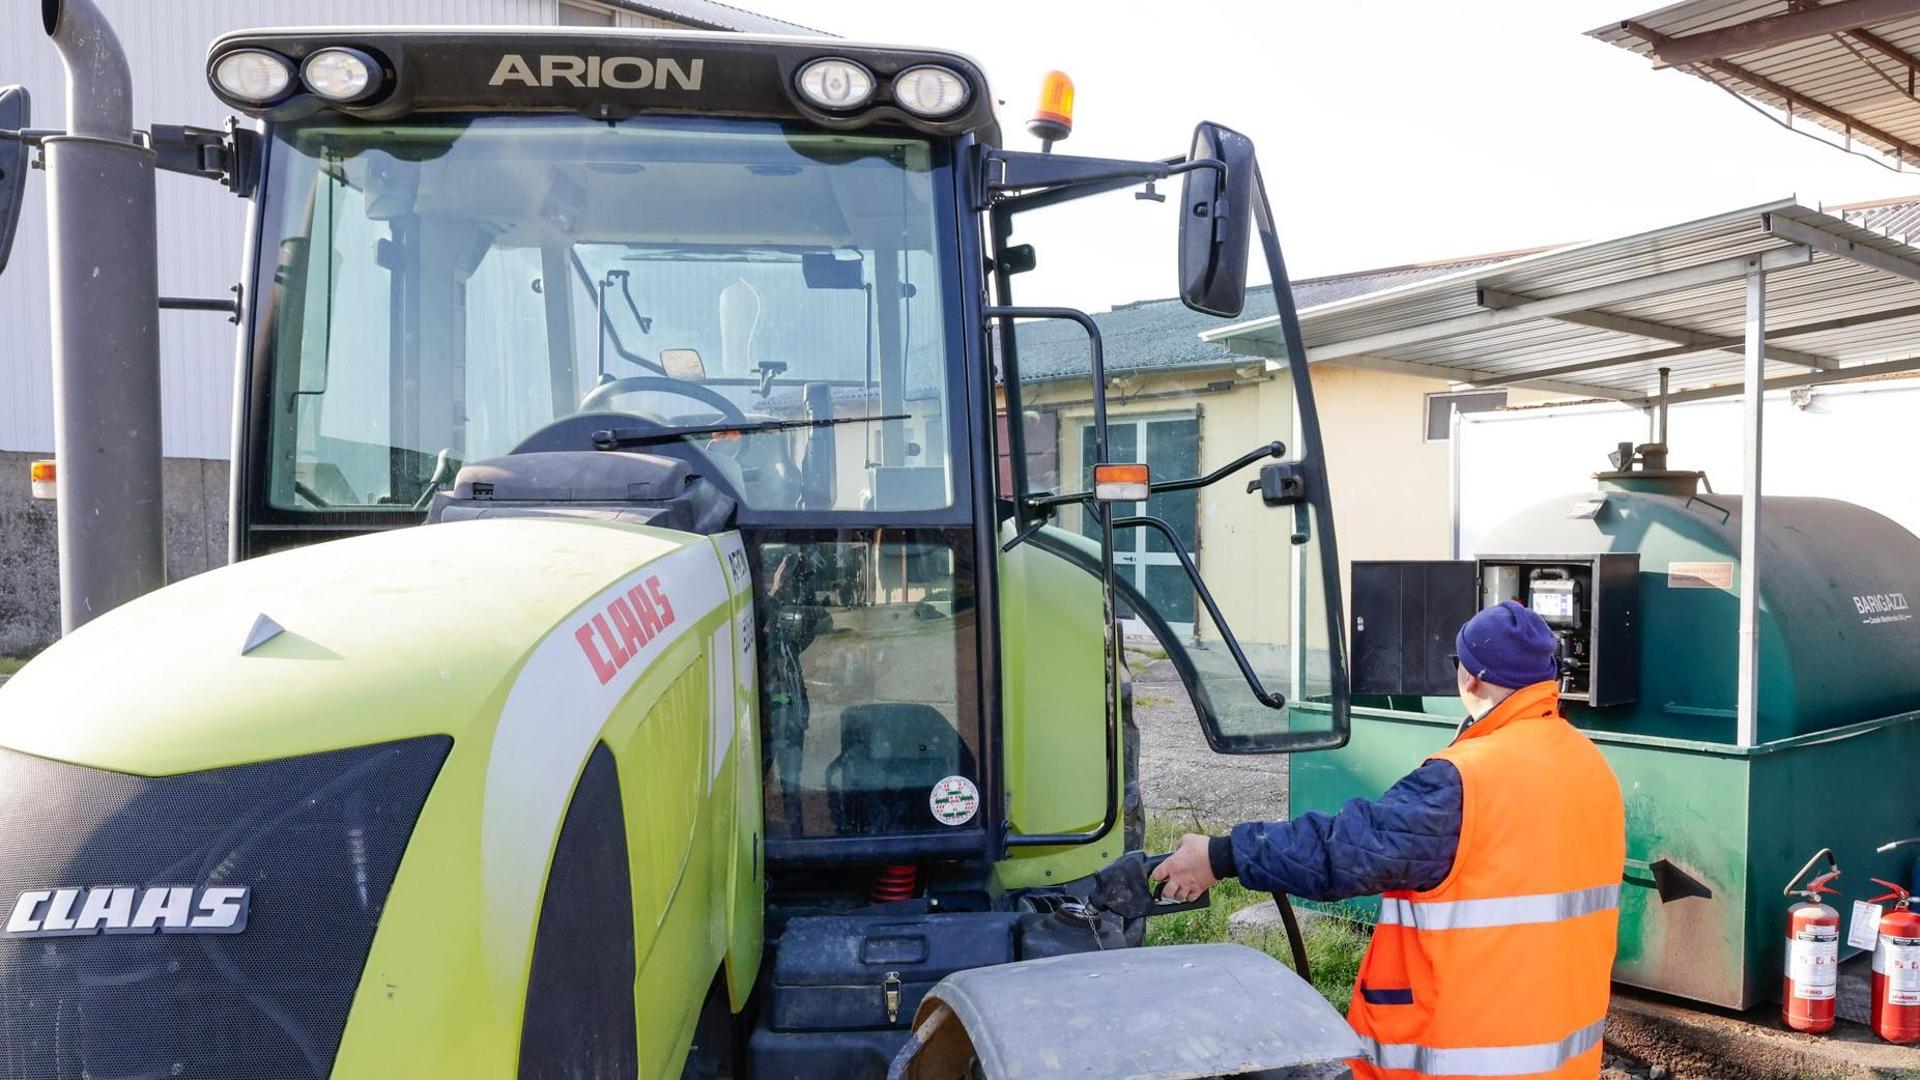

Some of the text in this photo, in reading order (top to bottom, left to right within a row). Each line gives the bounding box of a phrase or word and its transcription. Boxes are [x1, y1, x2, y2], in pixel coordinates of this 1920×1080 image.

[488, 54, 704, 90] ARION
[1853, 593, 1909, 614] BARIGAZZI
[575, 575, 675, 685] CLAAS
[6, 887, 246, 932] CLAAS
